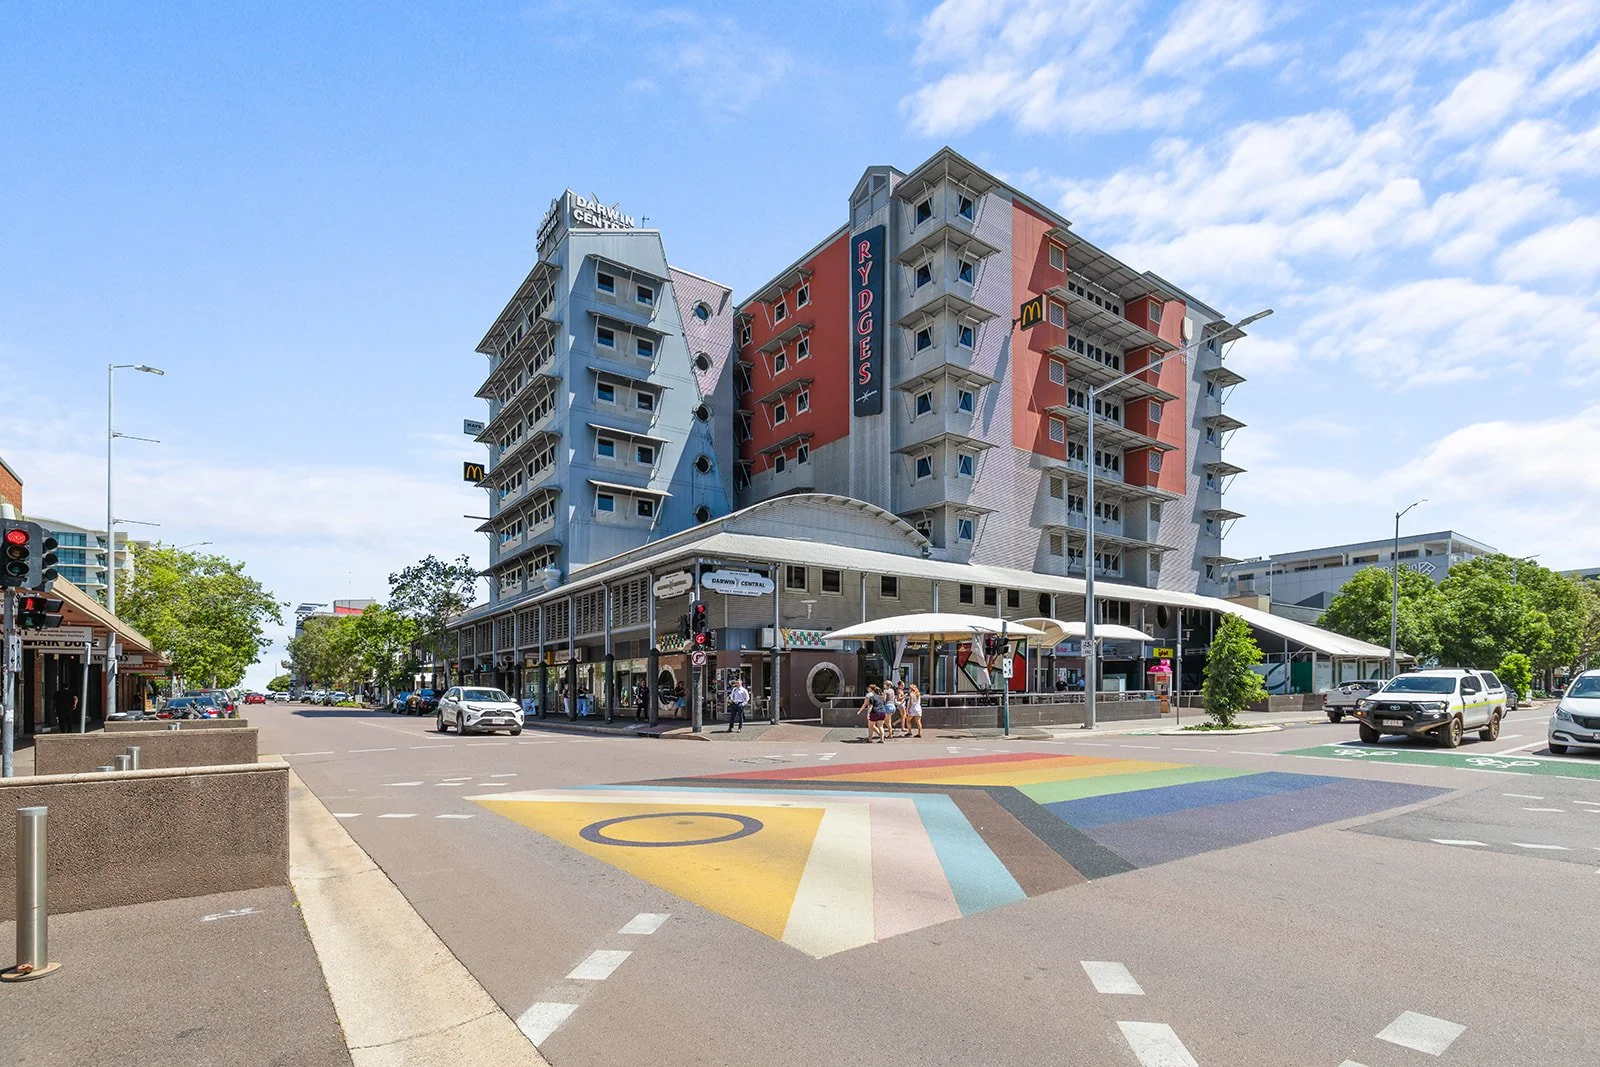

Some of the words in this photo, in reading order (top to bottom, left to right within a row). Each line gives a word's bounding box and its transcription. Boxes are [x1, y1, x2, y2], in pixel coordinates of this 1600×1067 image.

[573, 209, 631, 229] CENTR
[576, 196, 635, 228] DARWIN
[857, 240, 874, 385] RYDGES
[740, 580, 766, 588] CENTRAL
